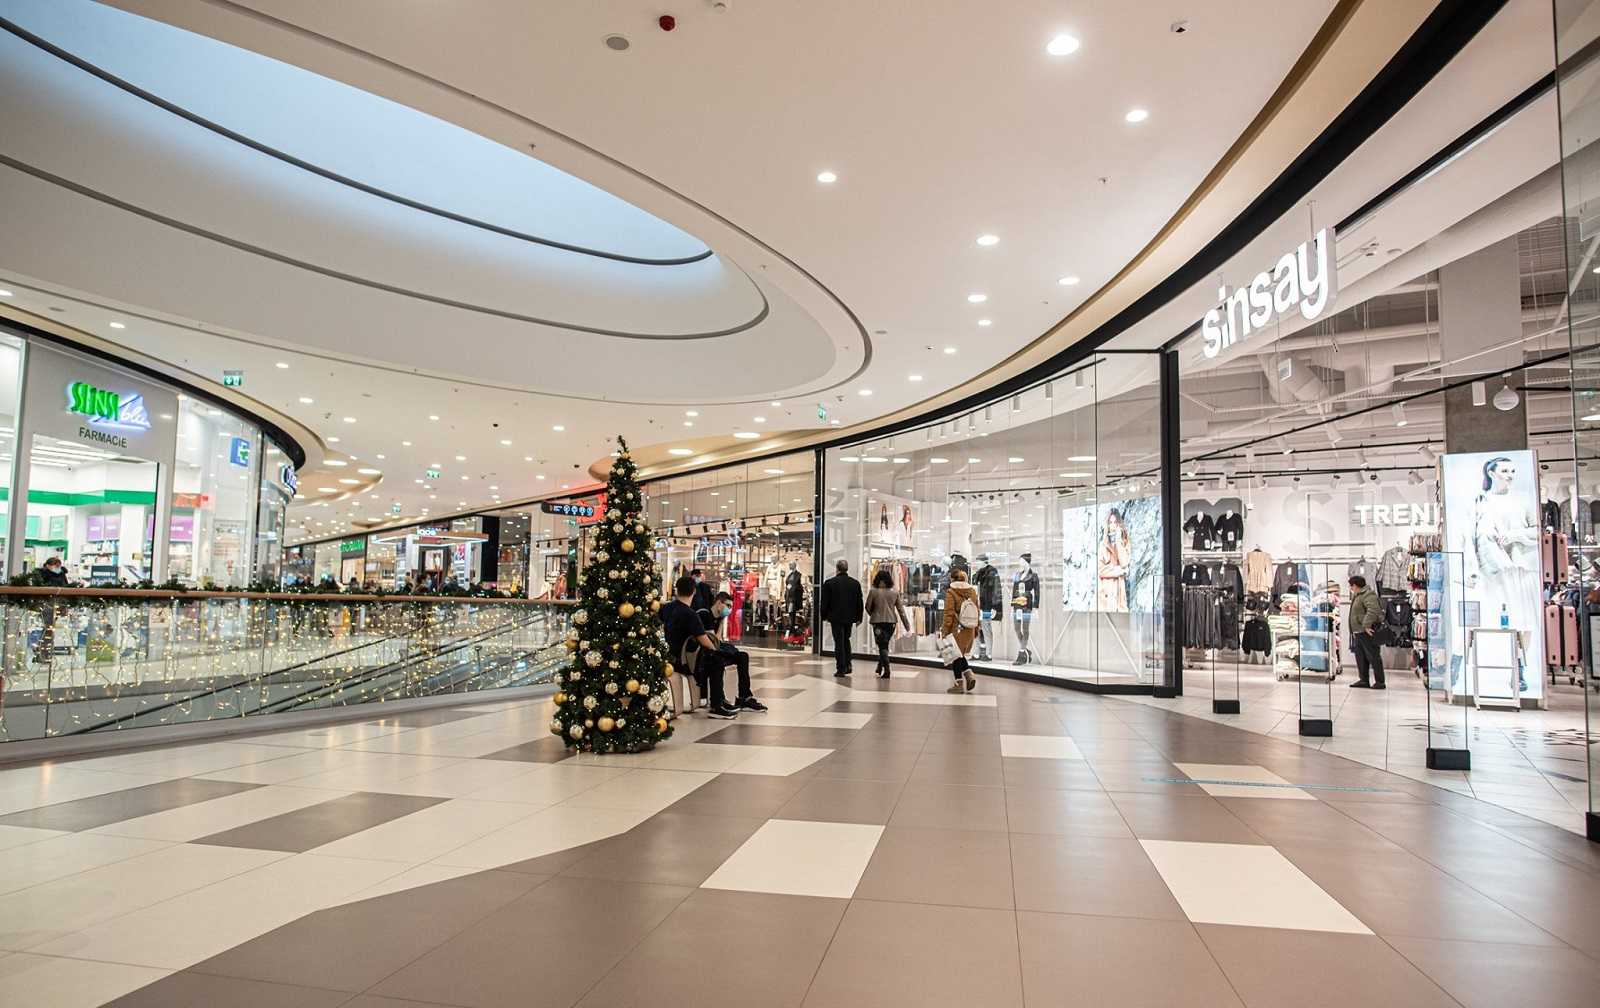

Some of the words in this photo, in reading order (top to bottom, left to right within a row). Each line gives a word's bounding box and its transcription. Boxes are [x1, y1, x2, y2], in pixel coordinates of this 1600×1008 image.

[1202, 228, 1330, 358] sinsay
[79, 427, 128, 448] FARMACIE
[1355, 503, 1440, 526] TREN
